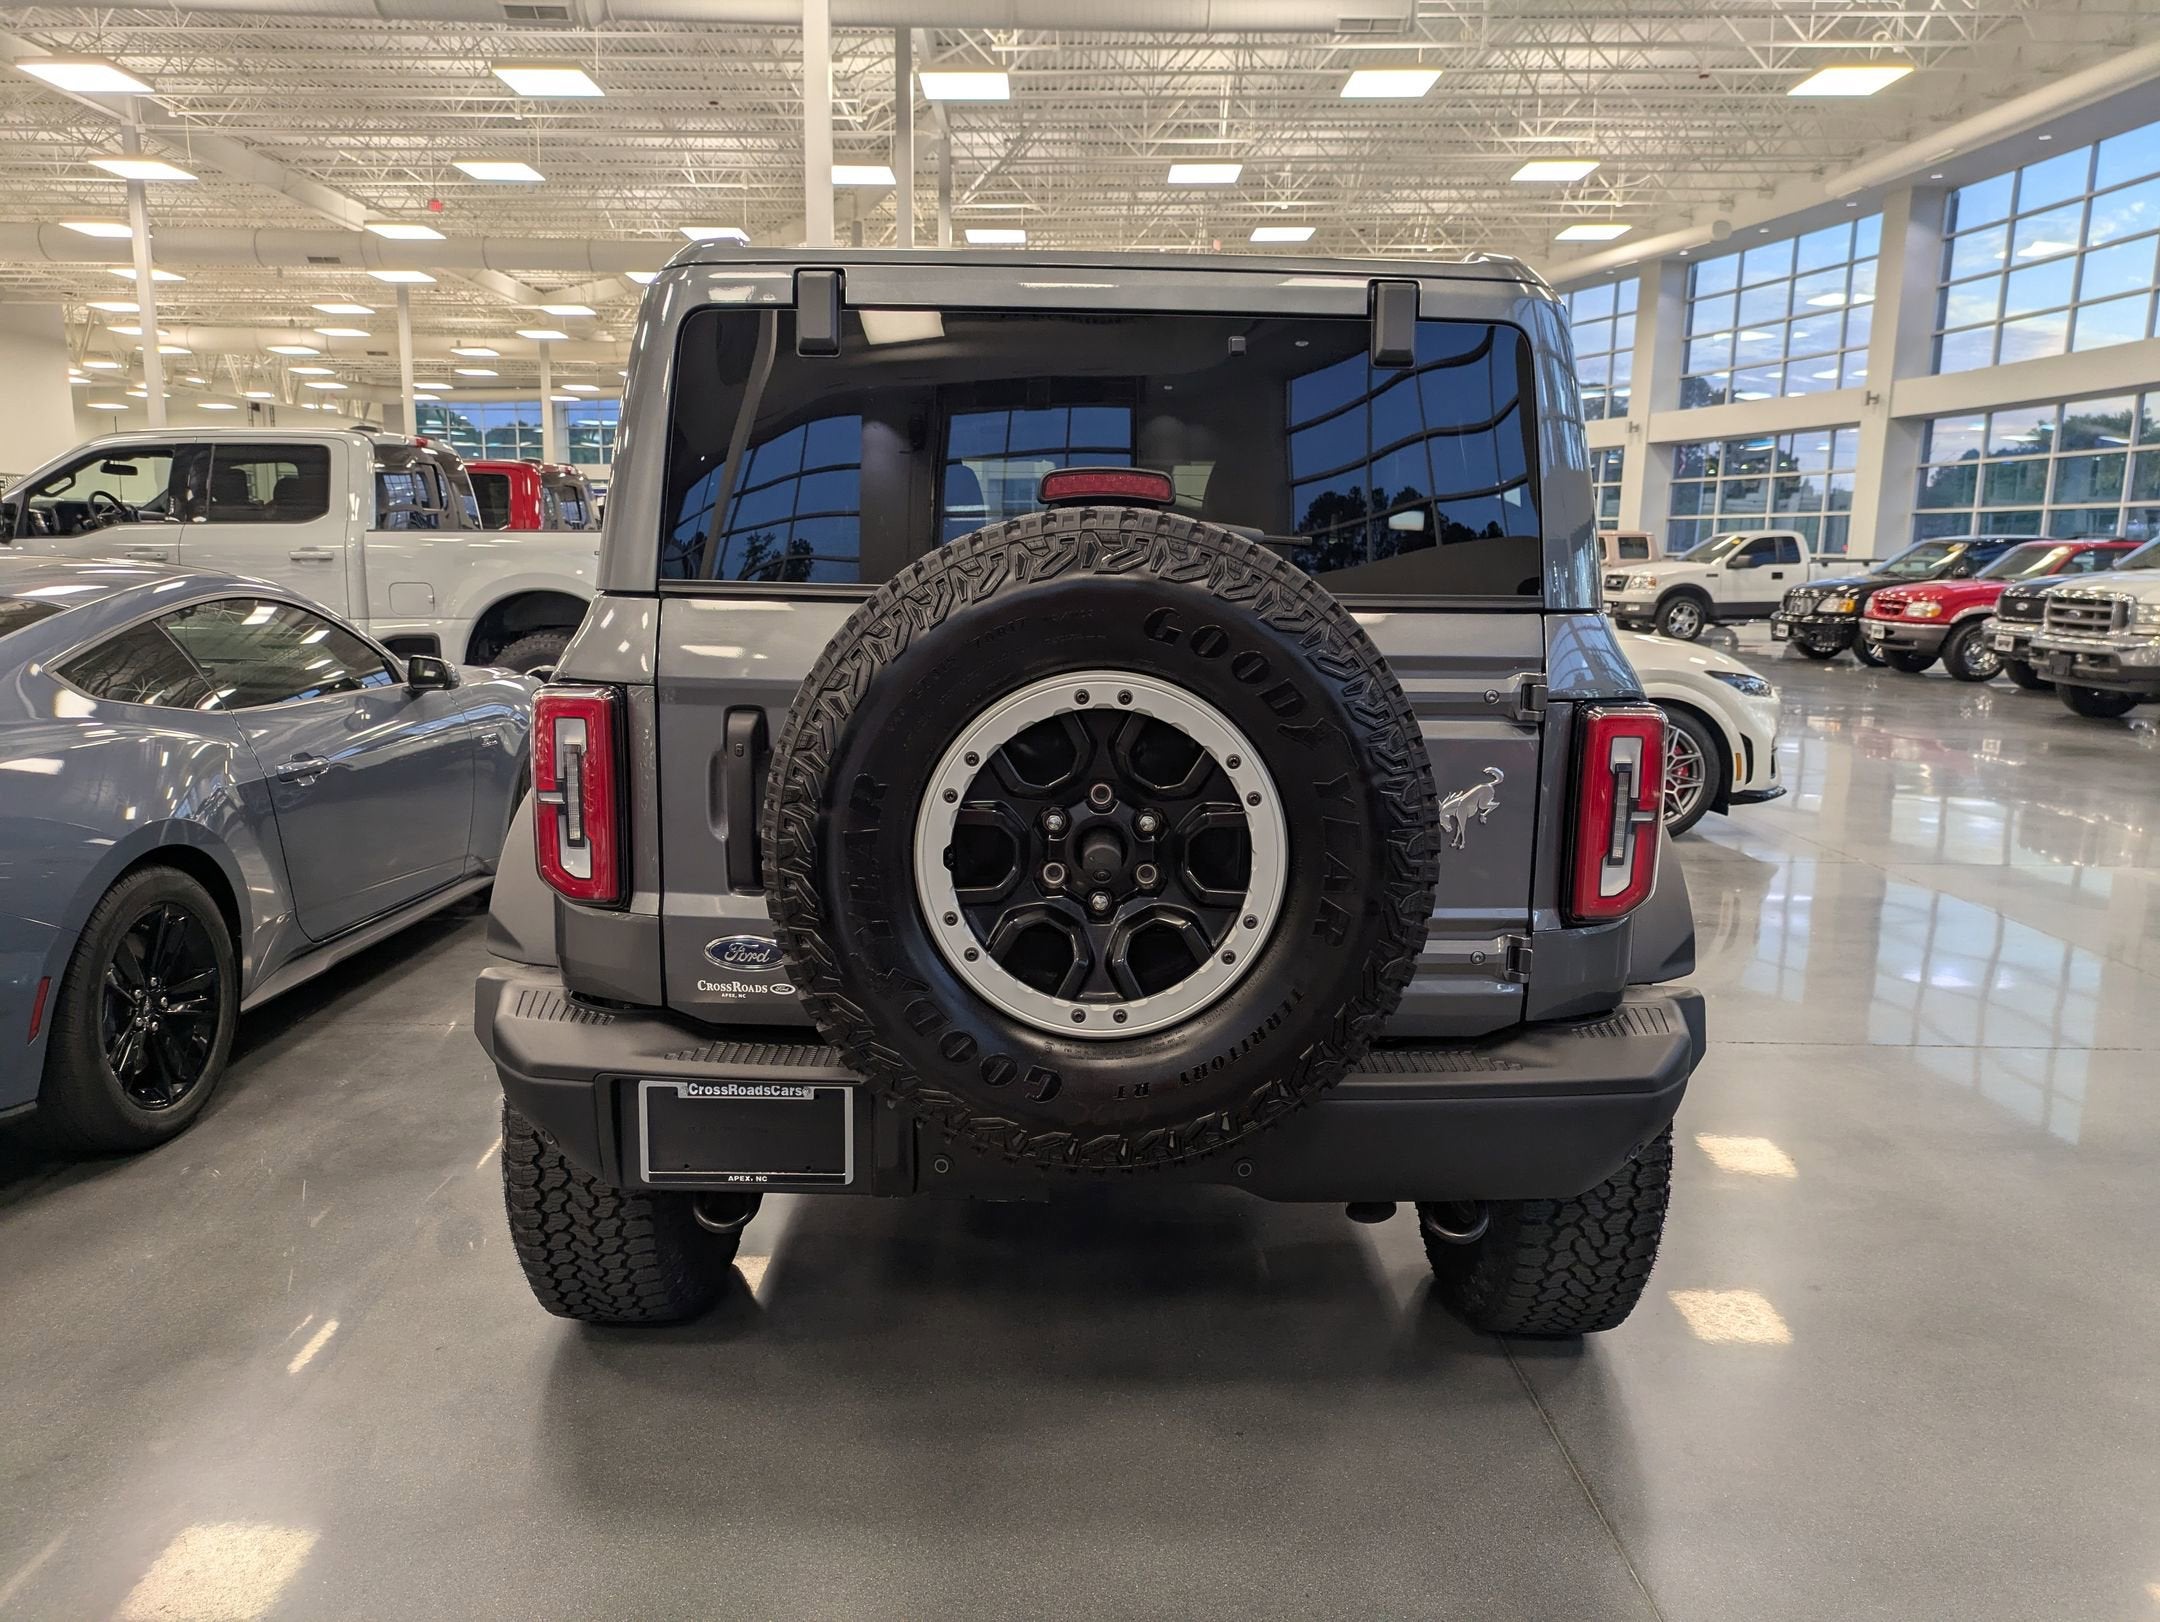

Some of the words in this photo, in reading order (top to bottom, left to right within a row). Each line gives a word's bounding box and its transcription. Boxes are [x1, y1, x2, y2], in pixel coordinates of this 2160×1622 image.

[724, 942, 771, 963] Ford
[1178, 986, 1307, 1087] TERRITORY
[688, 1082, 803, 1097] CrossRoadsCars
[1112, 1081, 1151, 1102] RT
